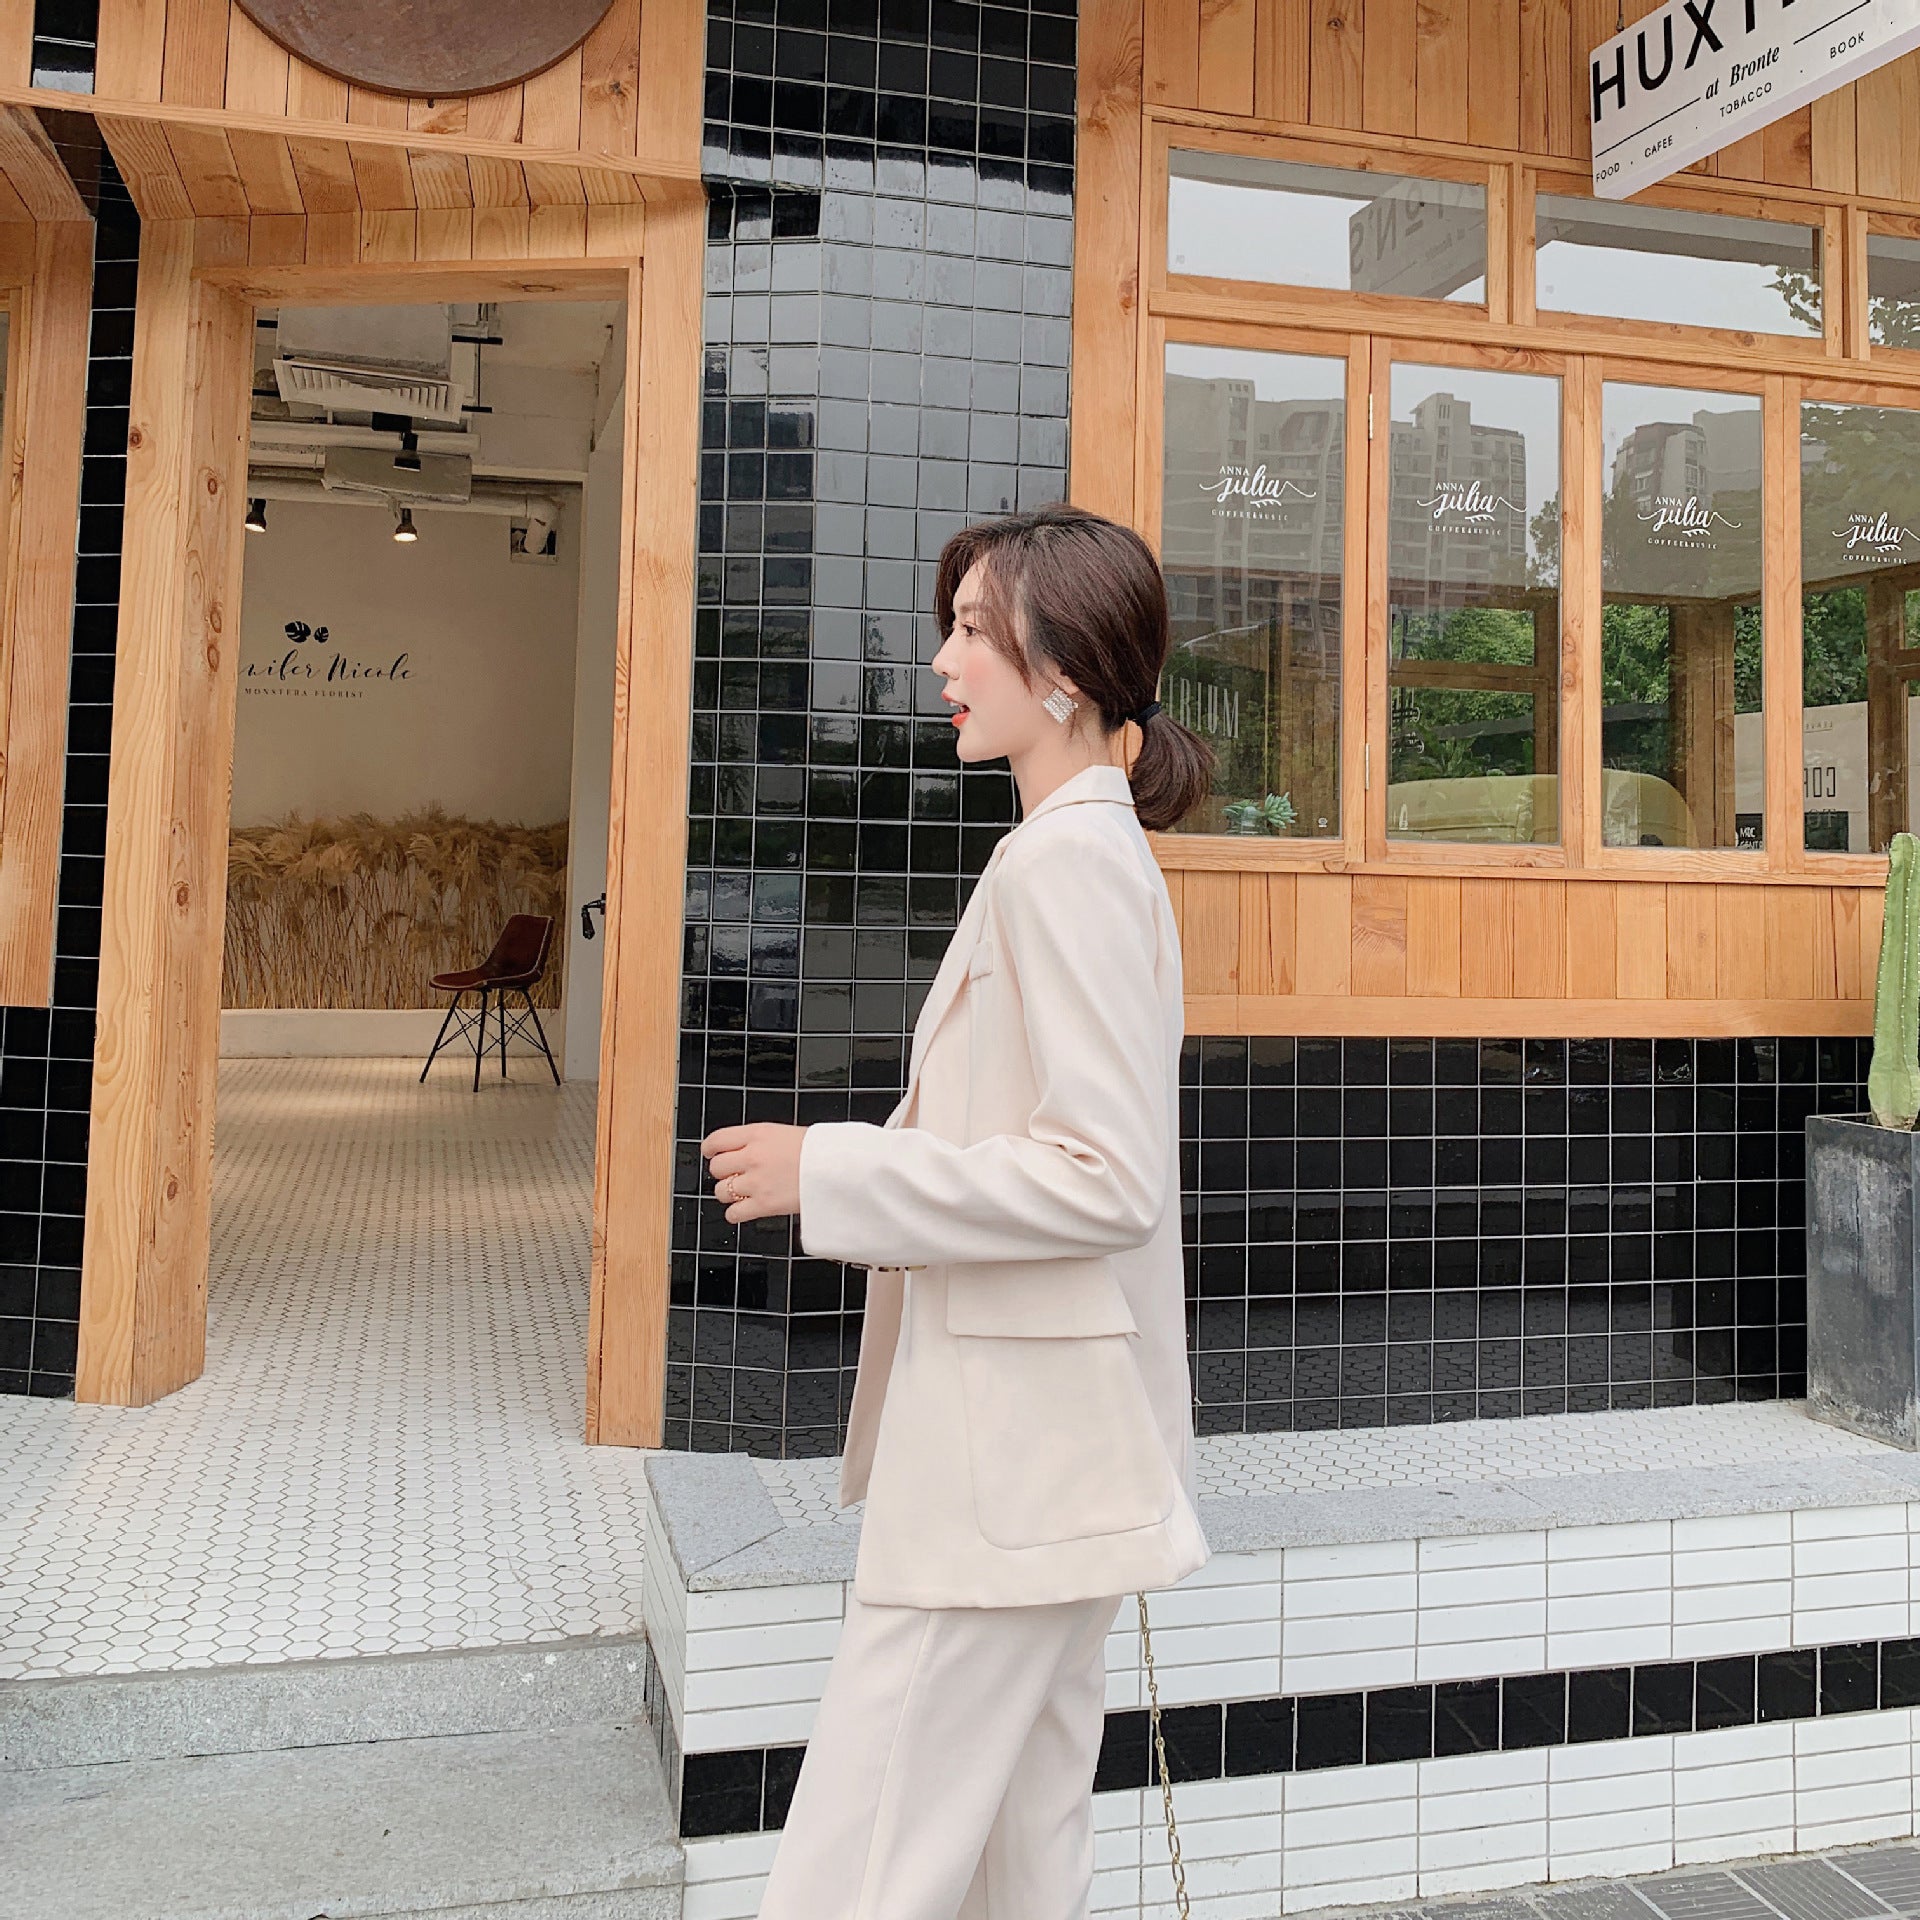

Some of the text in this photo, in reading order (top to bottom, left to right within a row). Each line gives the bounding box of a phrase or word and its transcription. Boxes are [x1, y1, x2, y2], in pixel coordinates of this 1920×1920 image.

[1705, 46, 1780, 100] at Bronte
[1595, 31, 1866, 183] FOOD CAFEE TOBACCO BOOK
[1199, 464, 1317, 502] julia
[1219, 465, 1250, 477] ANNA
[1435, 482, 1465, 493] ANNA
[1416, 480, 1529, 519] julia
[1637, 496, 1742, 532] julia
[1655, 496, 1683, 507] ANNA
[1831, 511, 1920, 549] julia
[1848, 514, 1874, 524] ANNA
[327, 652, 417, 682] Nicole
[314, 690, 363, 698] FLORIST
